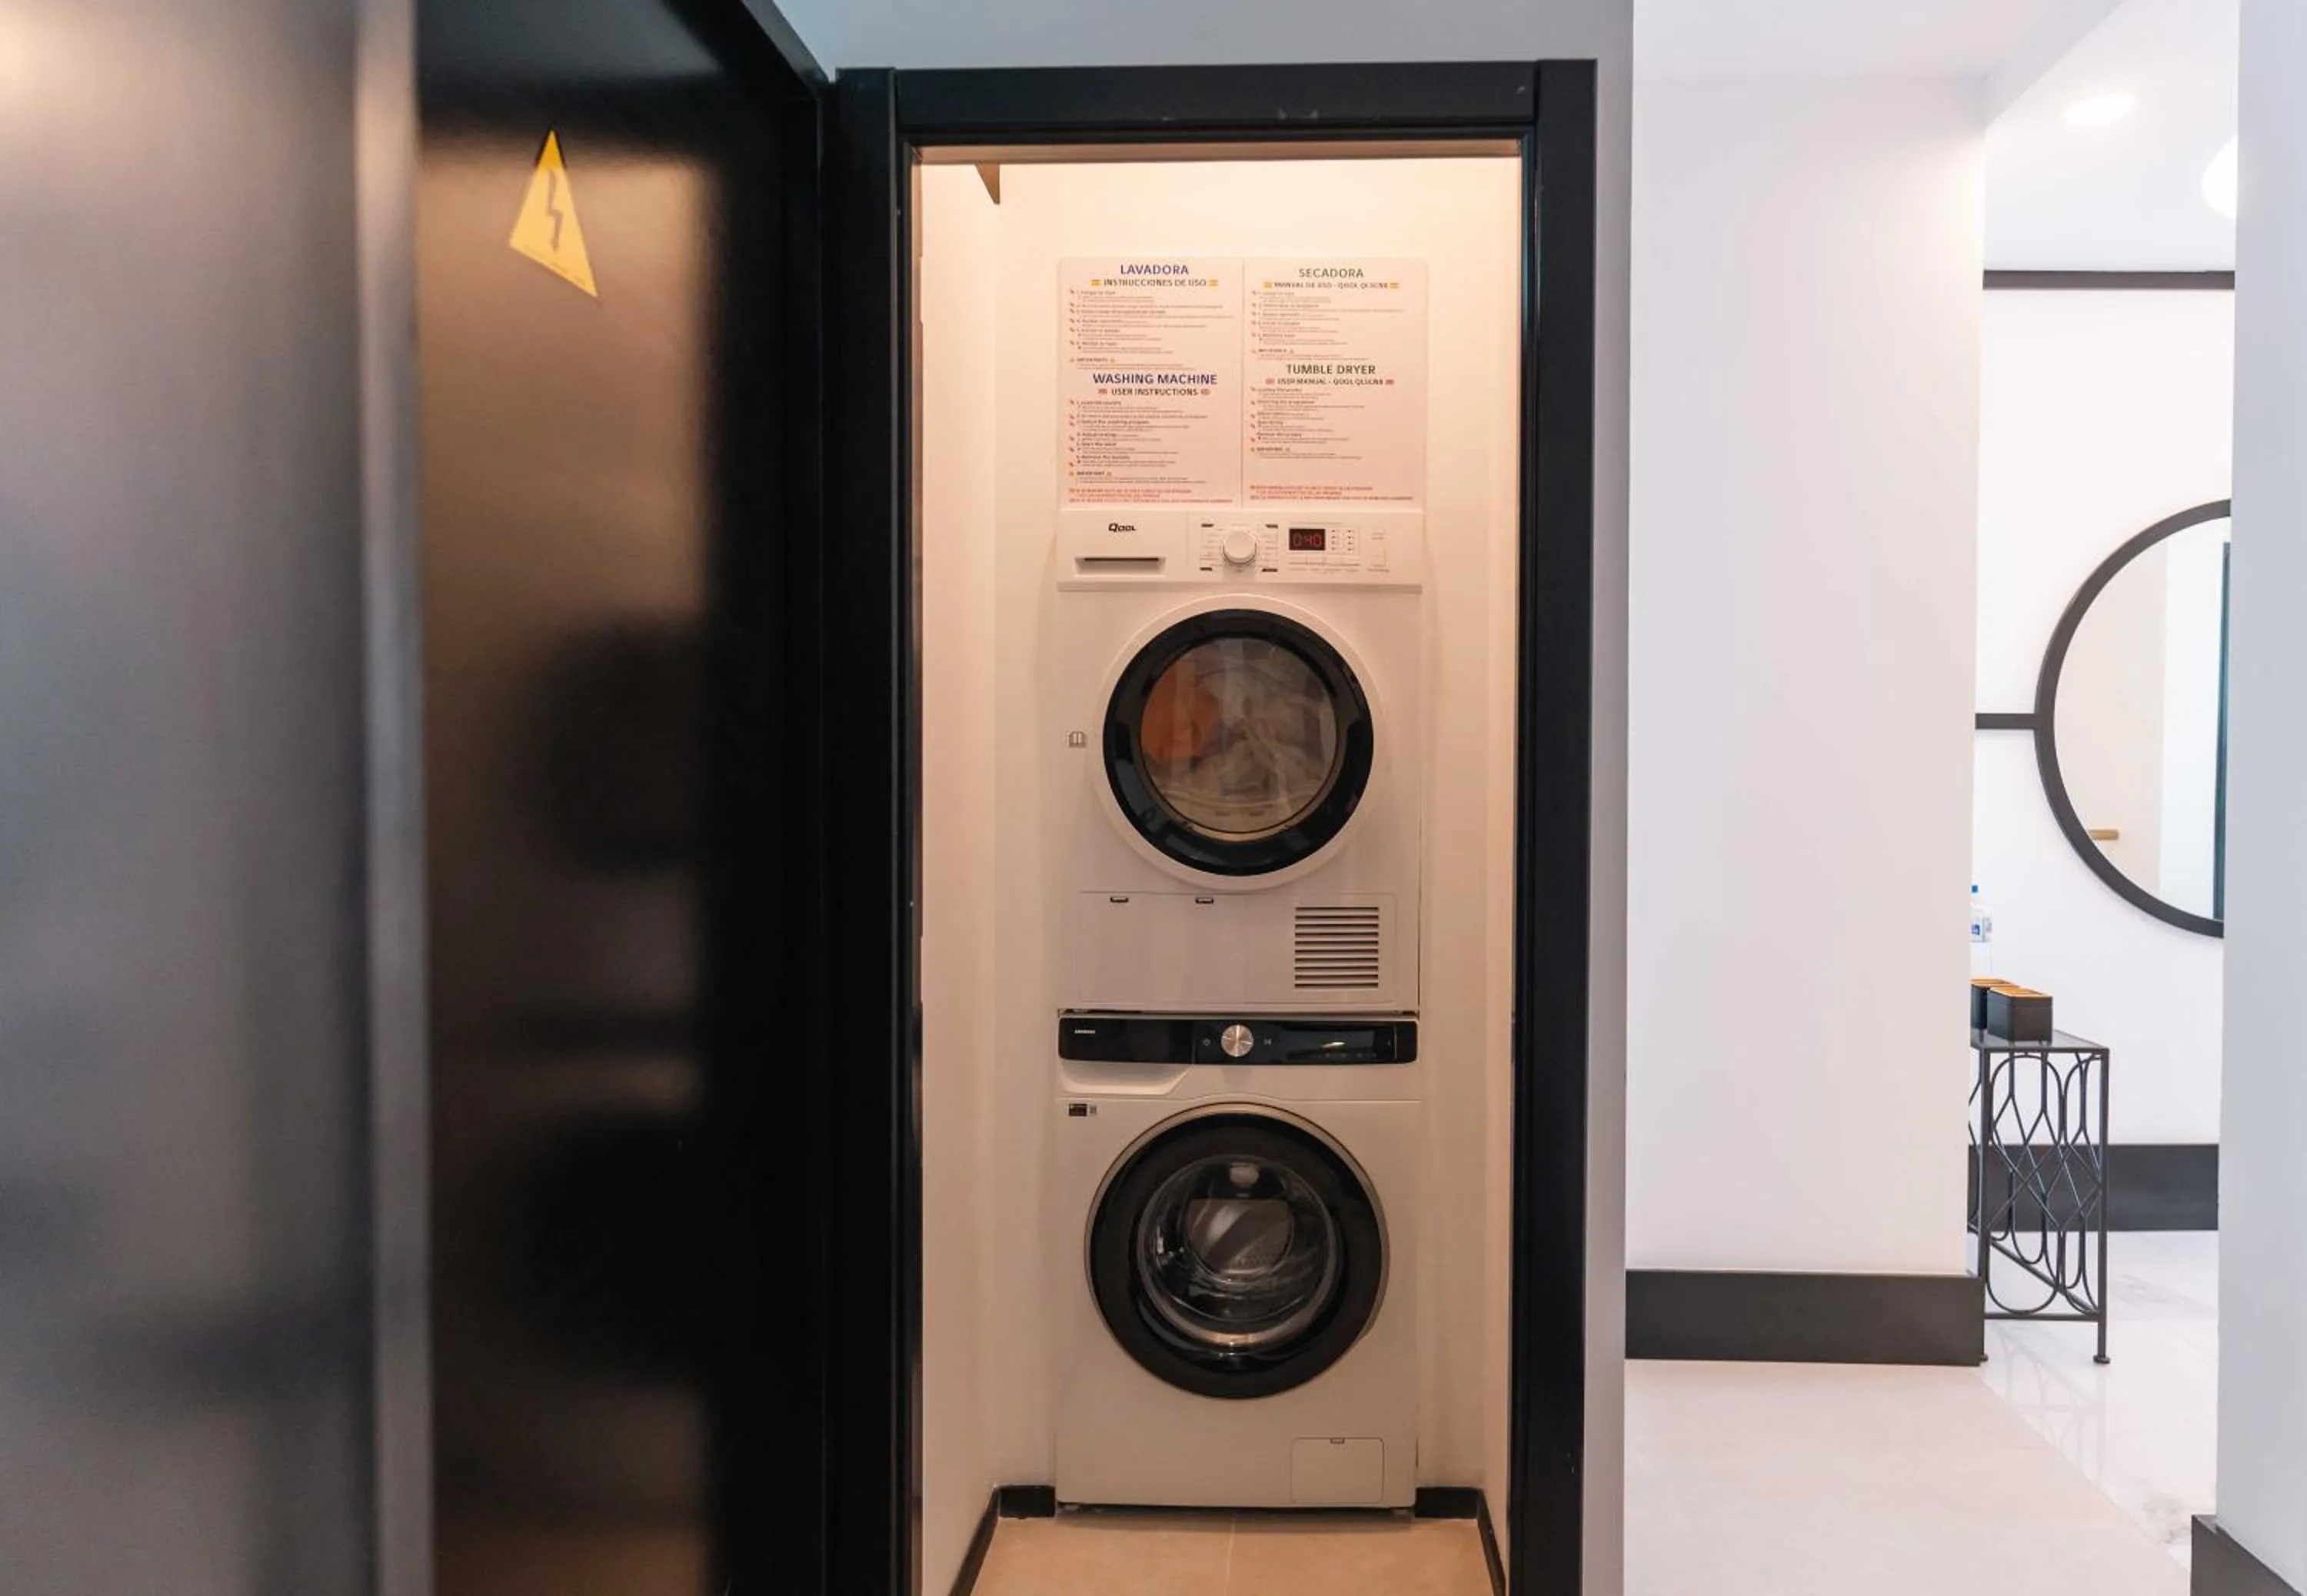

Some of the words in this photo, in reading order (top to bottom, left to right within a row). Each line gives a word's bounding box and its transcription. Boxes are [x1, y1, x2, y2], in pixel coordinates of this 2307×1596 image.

[1120, 264, 1190, 275] LAVADORA
[1298, 268, 1364, 278] SECADORA
[1104, 278, 1173, 287] INSTRUCCIONES
[1174, 278, 1187, 287] DE
[1188, 278, 1207, 287] USO
[1286, 364, 1333, 375] TUMBLE
[1337, 364, 1376, 375] DRYER
[1093, 372, 1154, 385] WASHING
[1157, 372, 1217, 385] MACHINE
[1111, 387, 1133, 396] USER
[1135, 387, 1198, 396] INSTRUCTIONS
